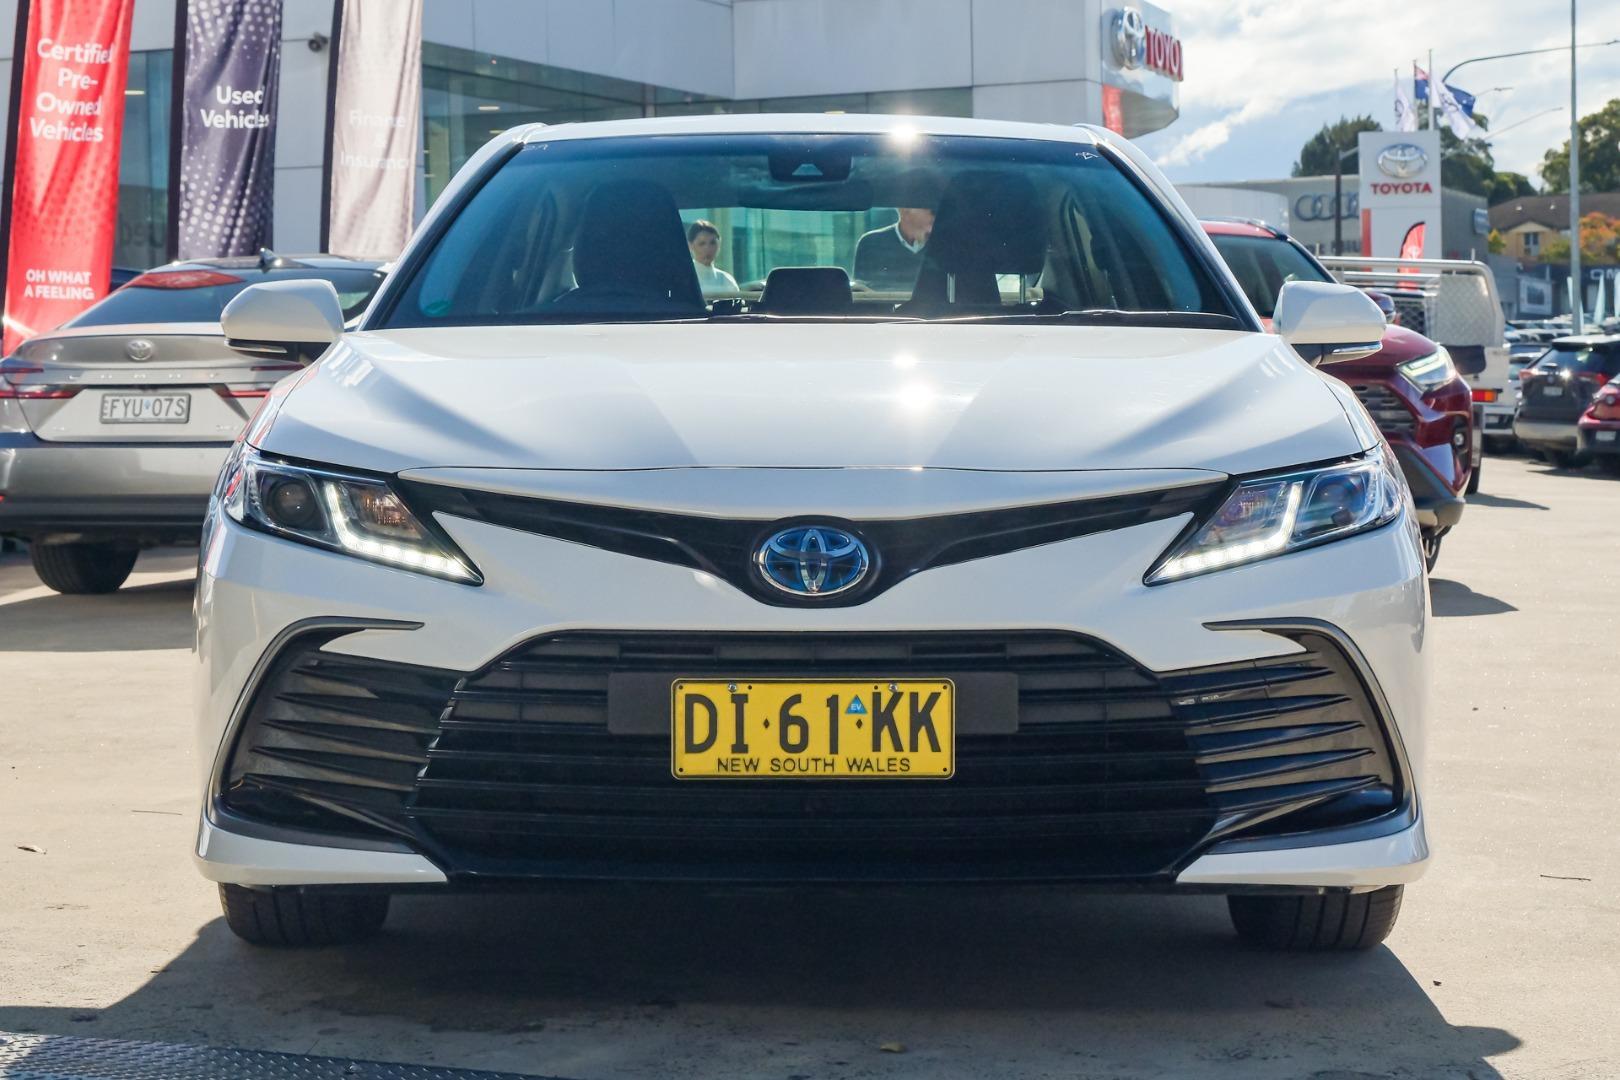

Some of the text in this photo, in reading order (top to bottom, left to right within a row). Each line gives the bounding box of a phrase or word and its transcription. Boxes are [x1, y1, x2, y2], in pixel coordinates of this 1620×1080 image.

[58, 67, 98, 89] Pre-
[36, 92, 102, 115] Owned
[200, 108, 269, 128] Vehicles
[30, 117, 103, 142] Vehicles
[1370, 182, 1432, 195] TOYOTA
[26, 269, 91, 285] OH WHAT
[24, 285, 95, 300] A FEELING
[850, 703, 862, 711] EV
[717, 758, 911, 772] NEW SOUTH WALES
